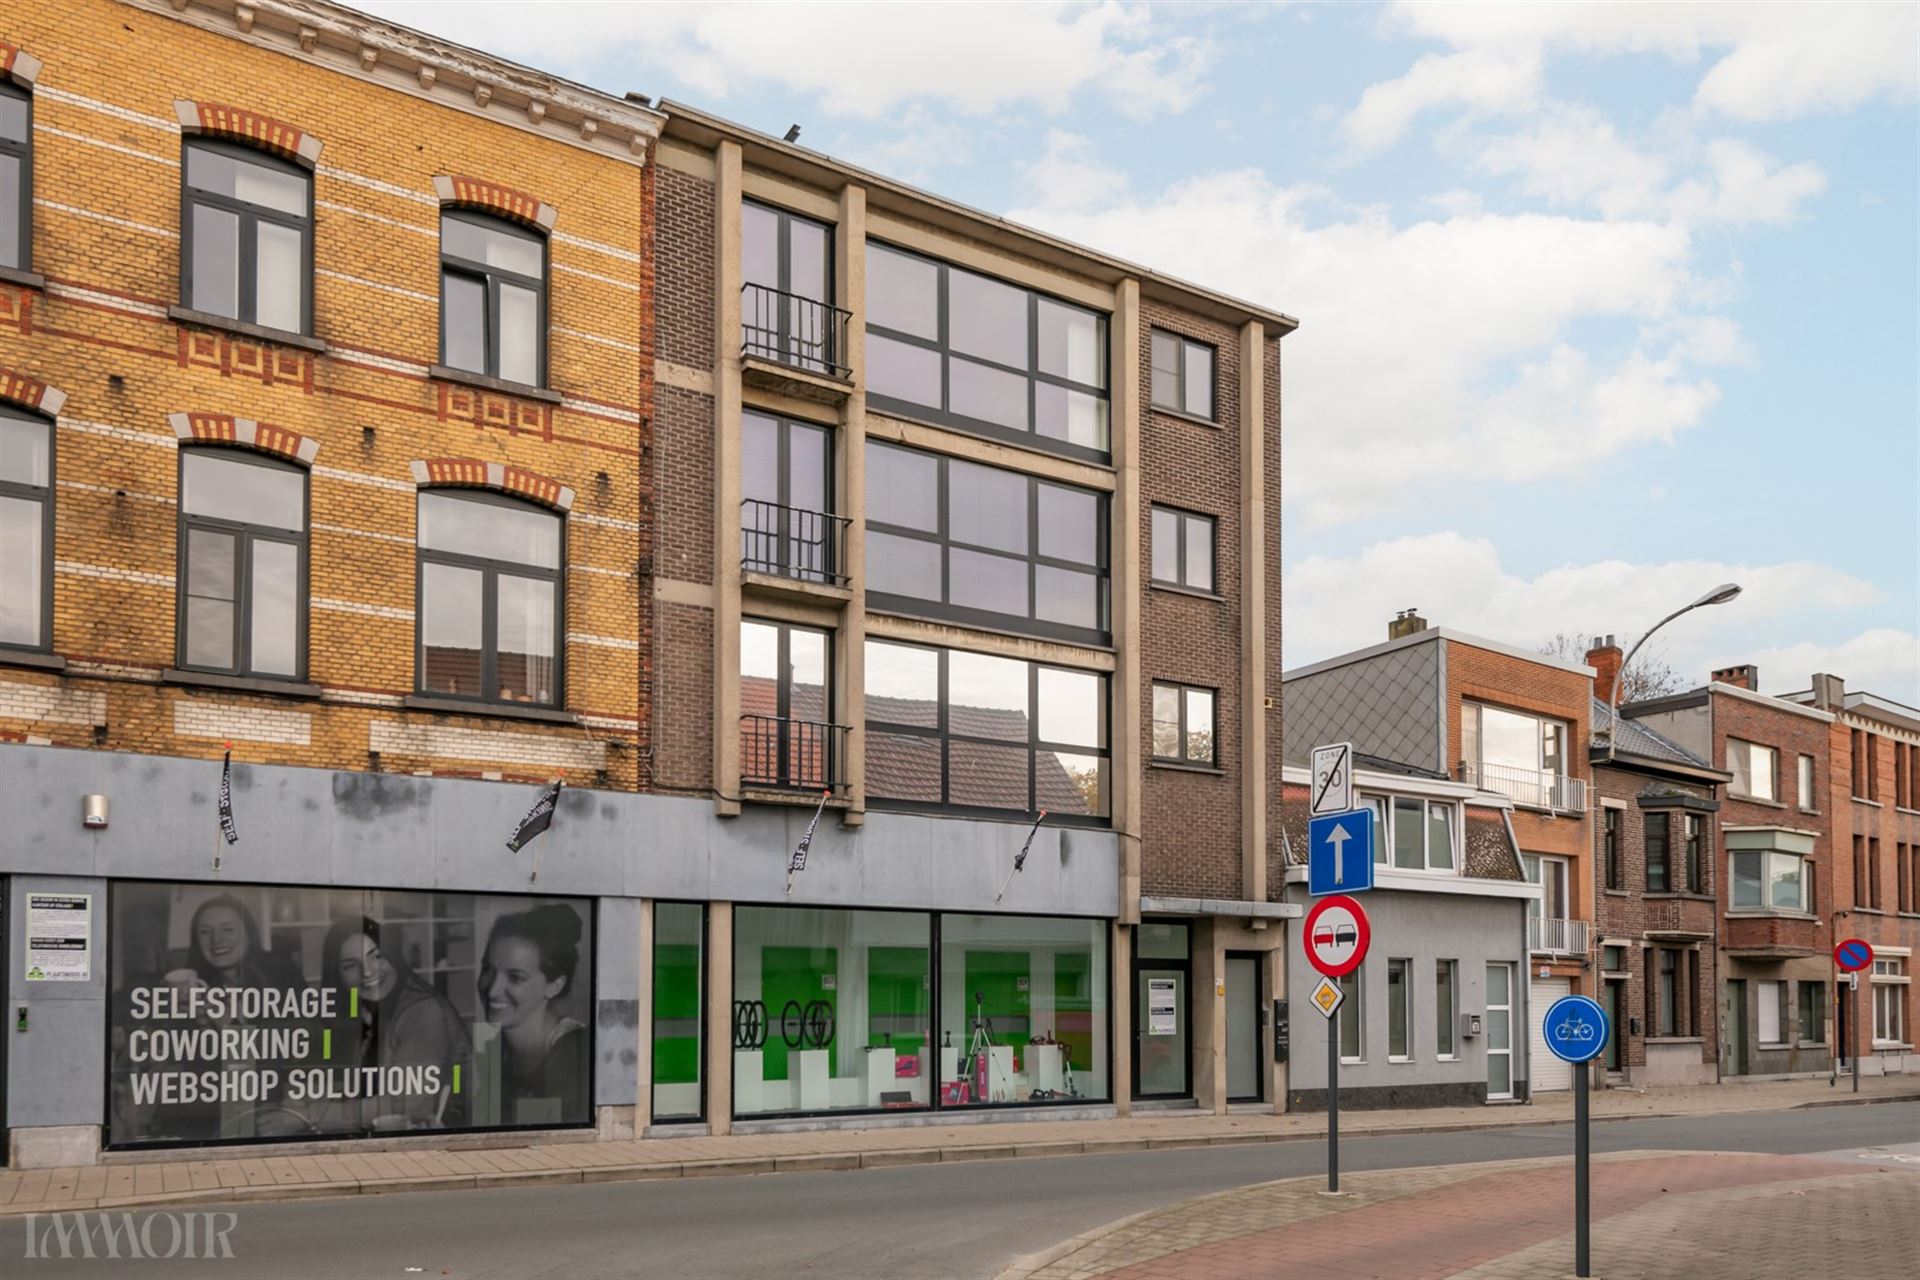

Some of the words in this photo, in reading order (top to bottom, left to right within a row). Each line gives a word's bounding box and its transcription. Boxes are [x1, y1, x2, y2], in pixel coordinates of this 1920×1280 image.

[1321, 750, 1341, 761] ZONE
[1319, 769, 1342, 789] 30
[130, 987, 337, 1019] SELFSTORAGE
[129, 1028, 310, 1062] COWORKING
[130, 1070, 279, 1106] WEBSHOP
[288, 1065, 441, 1100] SOLUTIONS
